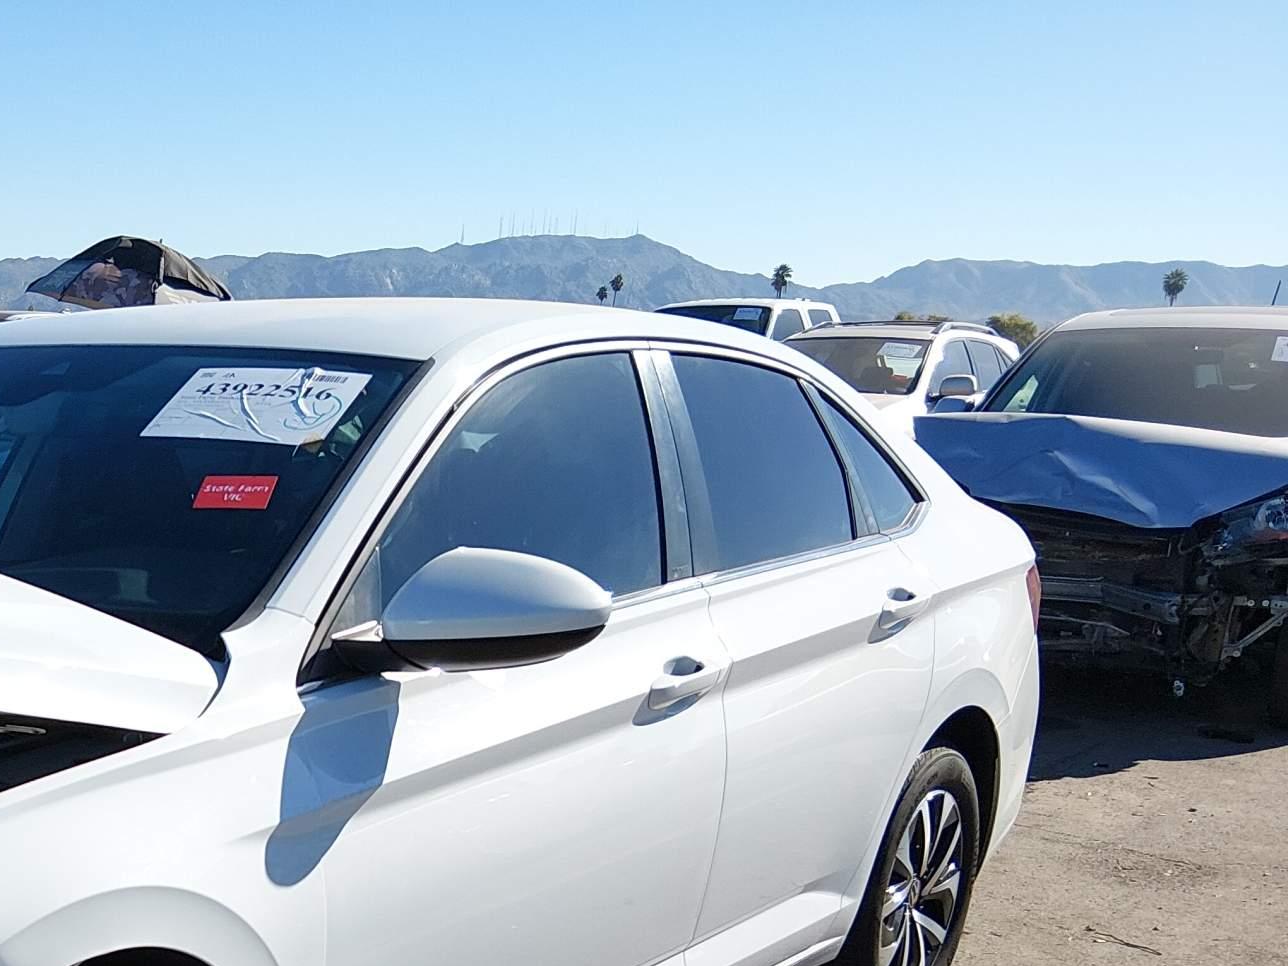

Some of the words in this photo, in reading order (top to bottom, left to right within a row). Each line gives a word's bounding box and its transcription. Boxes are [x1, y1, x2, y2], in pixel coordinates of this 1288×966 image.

[196, 382, 336, 402] 43922516
[203, 484, 234, 493] State
[238, 484, 269, 493] Farm
